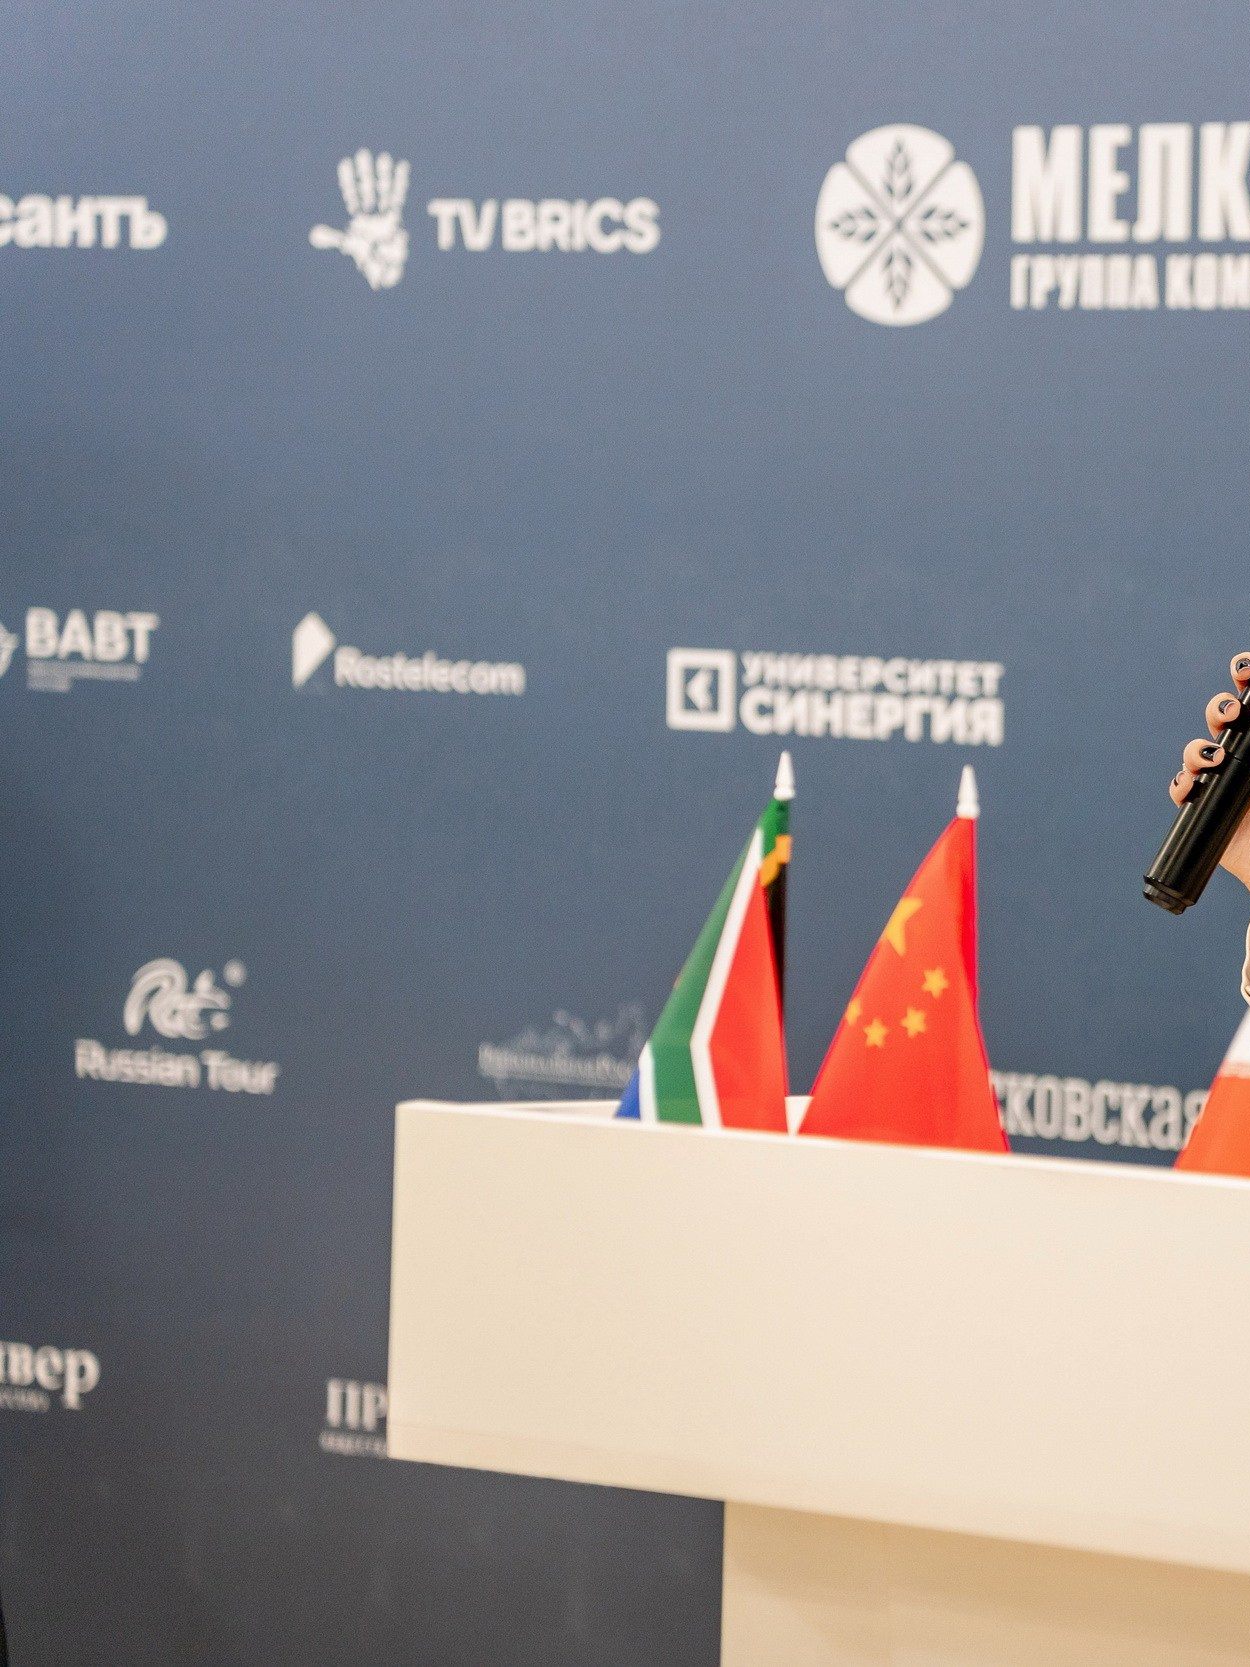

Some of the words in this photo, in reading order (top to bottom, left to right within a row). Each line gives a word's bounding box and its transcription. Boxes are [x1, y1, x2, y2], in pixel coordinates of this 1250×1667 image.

[502, 197, 660, 253] BRICS
[1010, 253, 1159, 309] ГРУППА
[334, 646, 526, 695] Rostelecom
[742, 651, 1003, 697] УНИВЕРСИТЕТ
[739, 686, 1004, 746] СИНЕРГИЯ
[75, 1038, 200, 1089] Russian
